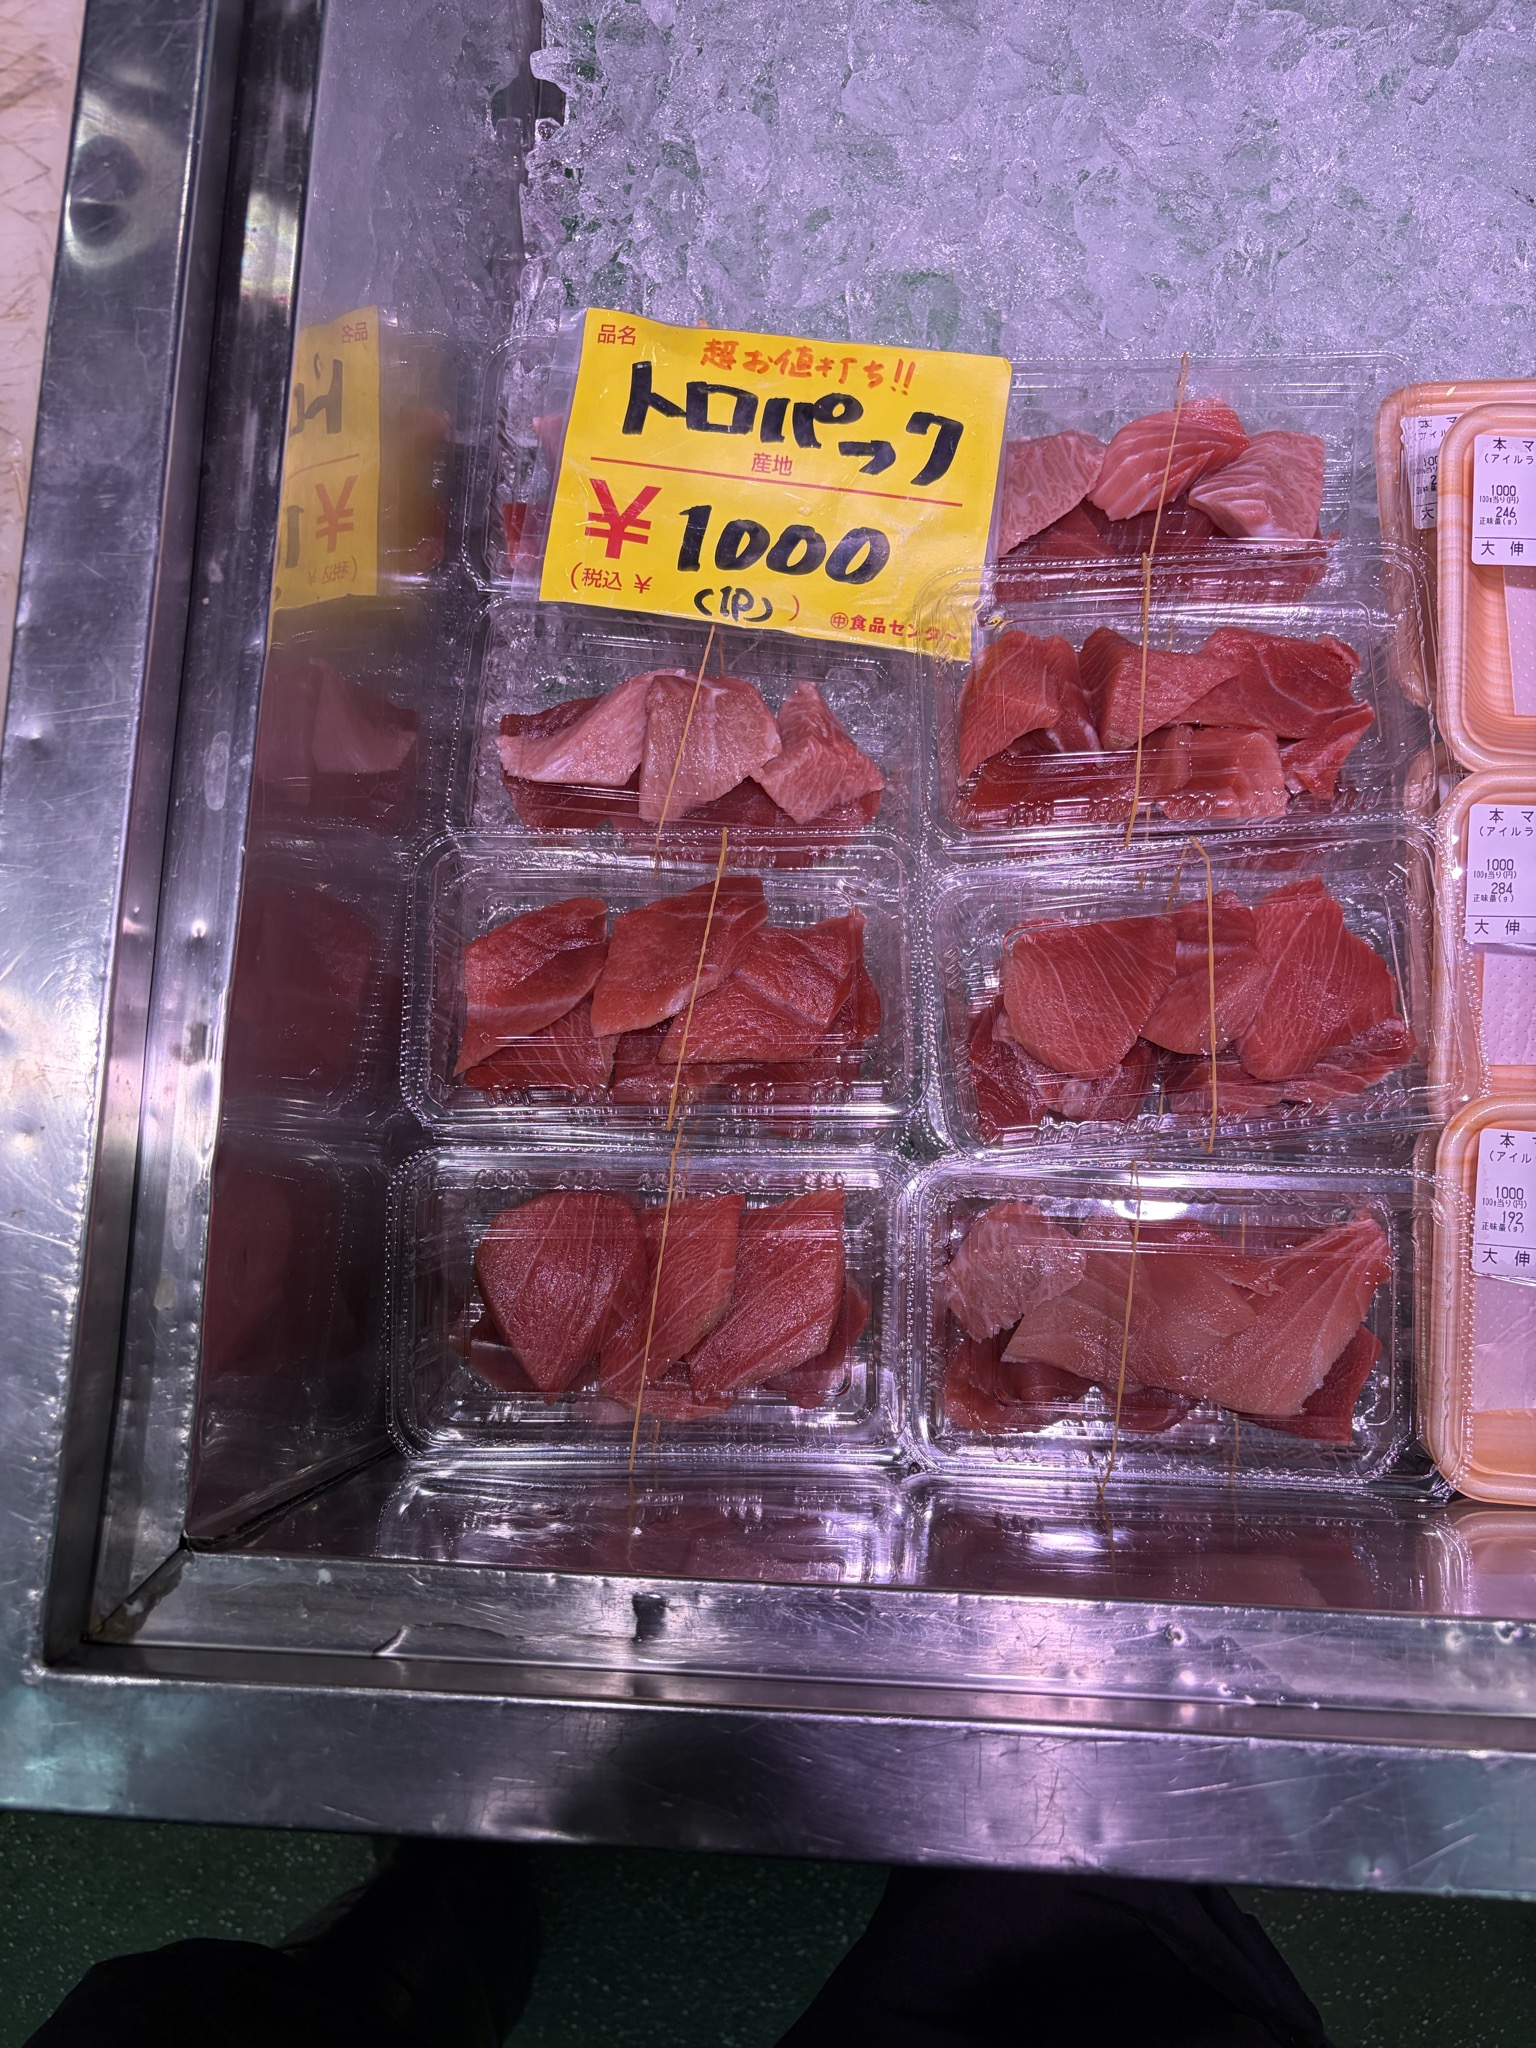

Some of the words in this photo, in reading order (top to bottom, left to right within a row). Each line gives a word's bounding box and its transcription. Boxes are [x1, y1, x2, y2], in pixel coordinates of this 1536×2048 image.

[597, 323, 637, 346] 品名
[621, 361, 964, 486] トロパック
[751, 452, 793, 477] 産地
[1491, 485, 1517, 496] 1000
[1495, 506, 1516, 518] 246
[677, 505, 890, 585] 1000
[571, 562, 622, 591] (税込
[1487, 859, 1514, 871] 1000
[1491, 882, 1513, 894] 284
[1490, 1150, 1536, 1163] (アイル
[1496, 1186, 1524, 1200] 1000
[1503, 1211, 1523, 1225] 192
